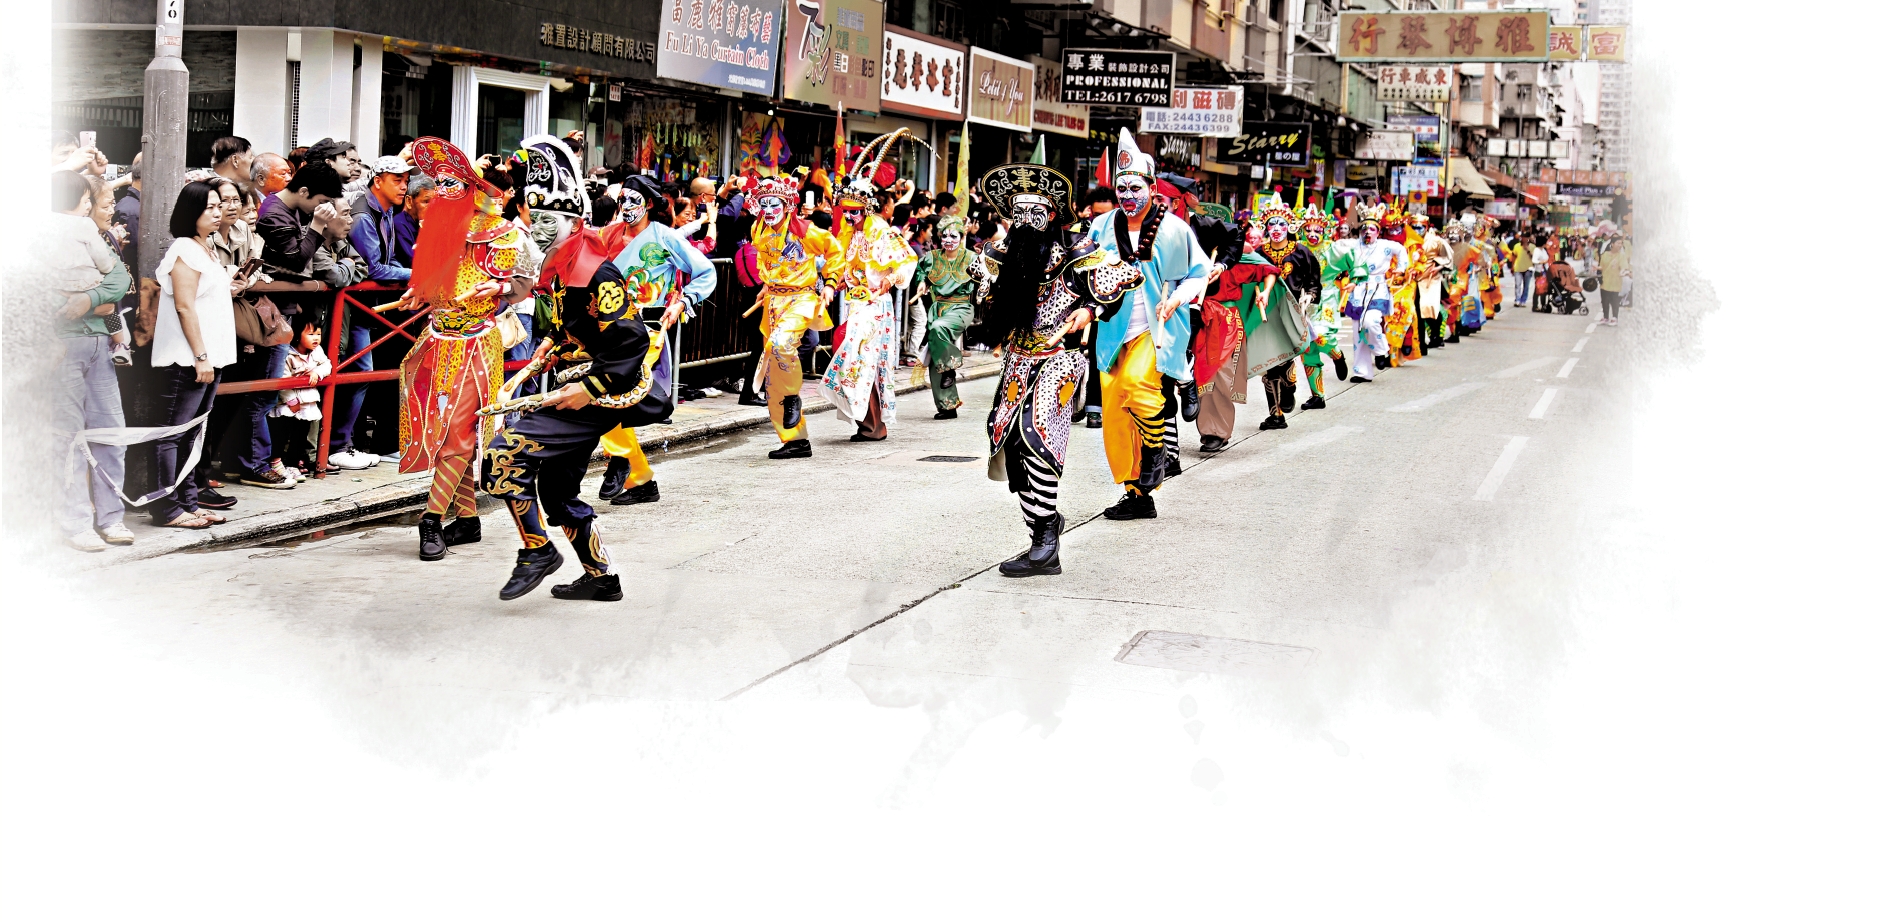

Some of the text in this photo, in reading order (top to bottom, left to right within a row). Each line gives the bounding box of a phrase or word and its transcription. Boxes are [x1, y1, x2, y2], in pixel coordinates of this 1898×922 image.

[540, 22, 656, 64] 雅置設計顧問有限公司
[665, 30, 770, 71] Fu Li Ya Curtain Cloth
[1067, 53, 1105, 71] 專業
[1066, 75, 1168, 89] PROFESSIONAL
[1007, 78, 1024, 115] You
[1134, 93, 1167, 104] 6798
[1228, 133, 1299, 155] Starry
